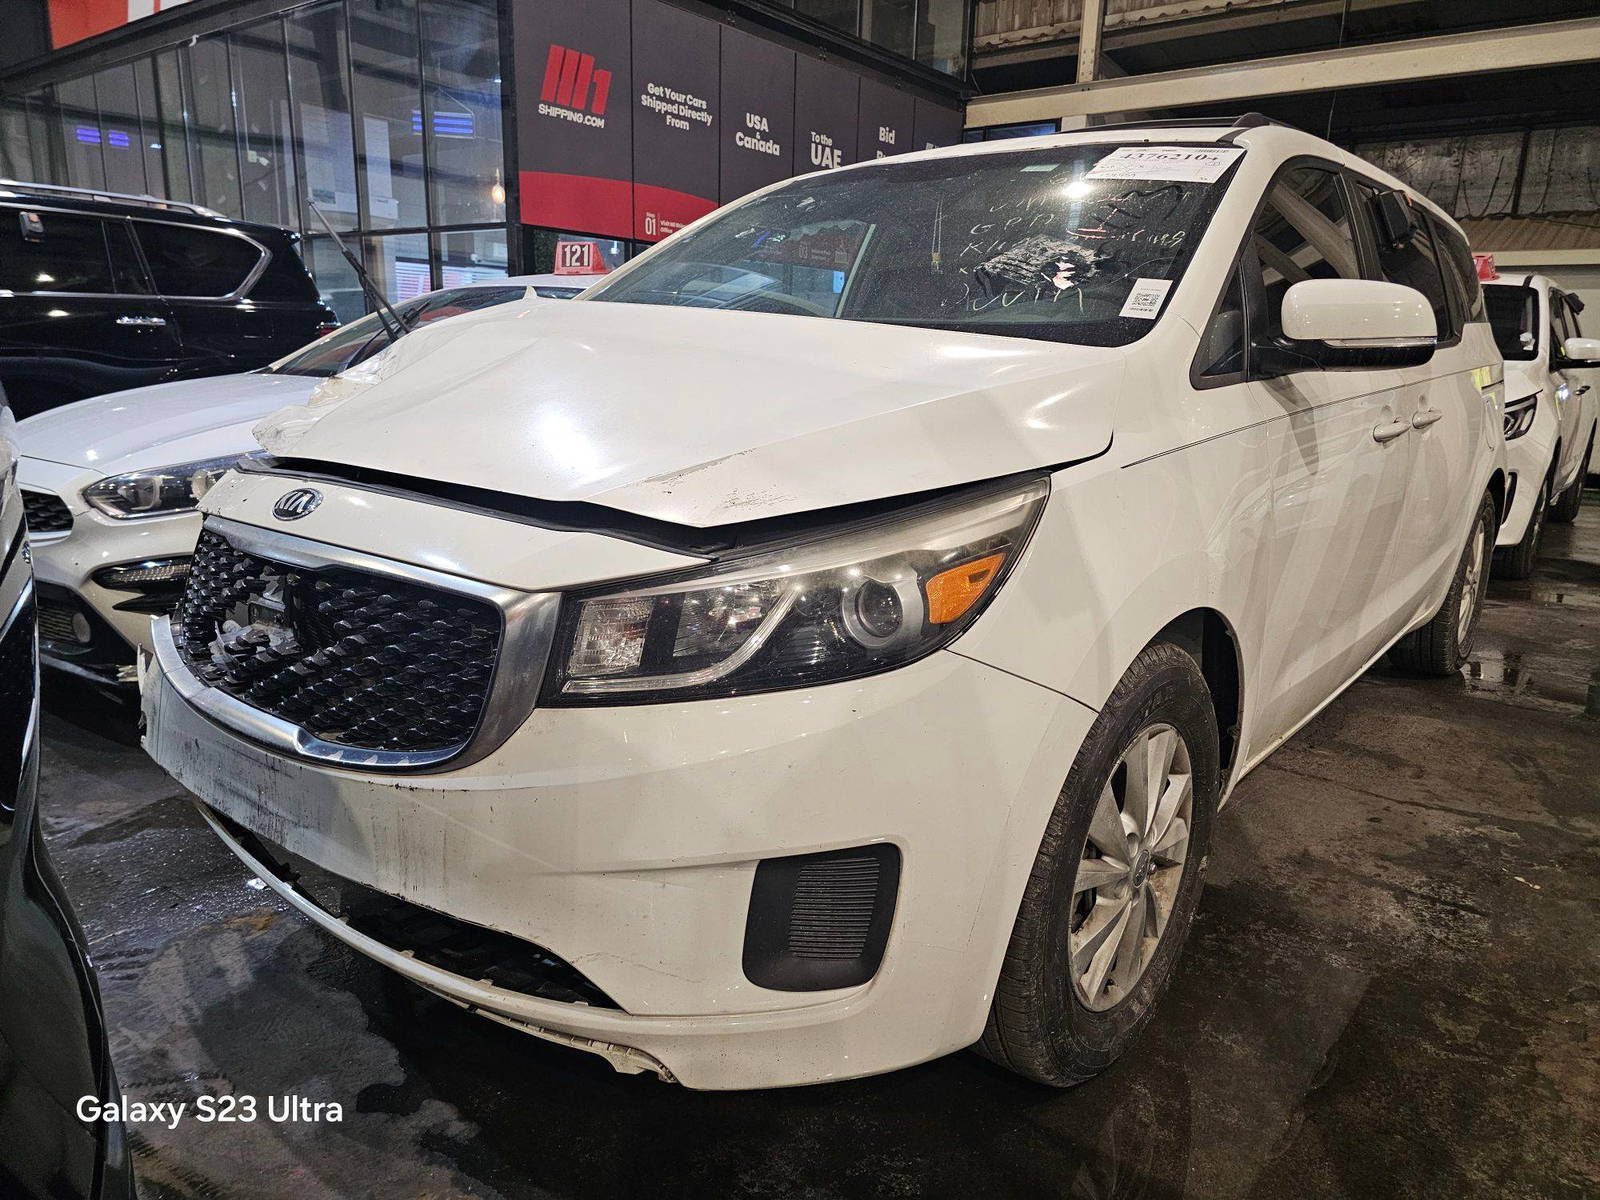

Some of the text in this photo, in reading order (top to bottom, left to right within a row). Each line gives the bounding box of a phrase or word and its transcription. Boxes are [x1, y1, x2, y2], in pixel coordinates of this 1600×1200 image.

[647, 83, 708, 109] Get Your Cars
[538, 103, 605, 128] SHIPPING.COM
[641, 94, 713, 126] Shipped Directly
[666, 115, 690, 130] From
[746, 112, 769, 132] USA
[735, 131, 781, 156] Canada
[810, 131, 833, 146] To the
[878, 126, 896, 145] Bid
[810, 143, 842, 169] UAE
[645, 216, 657, 236] 01
[564, 244, 589, 267] 121
